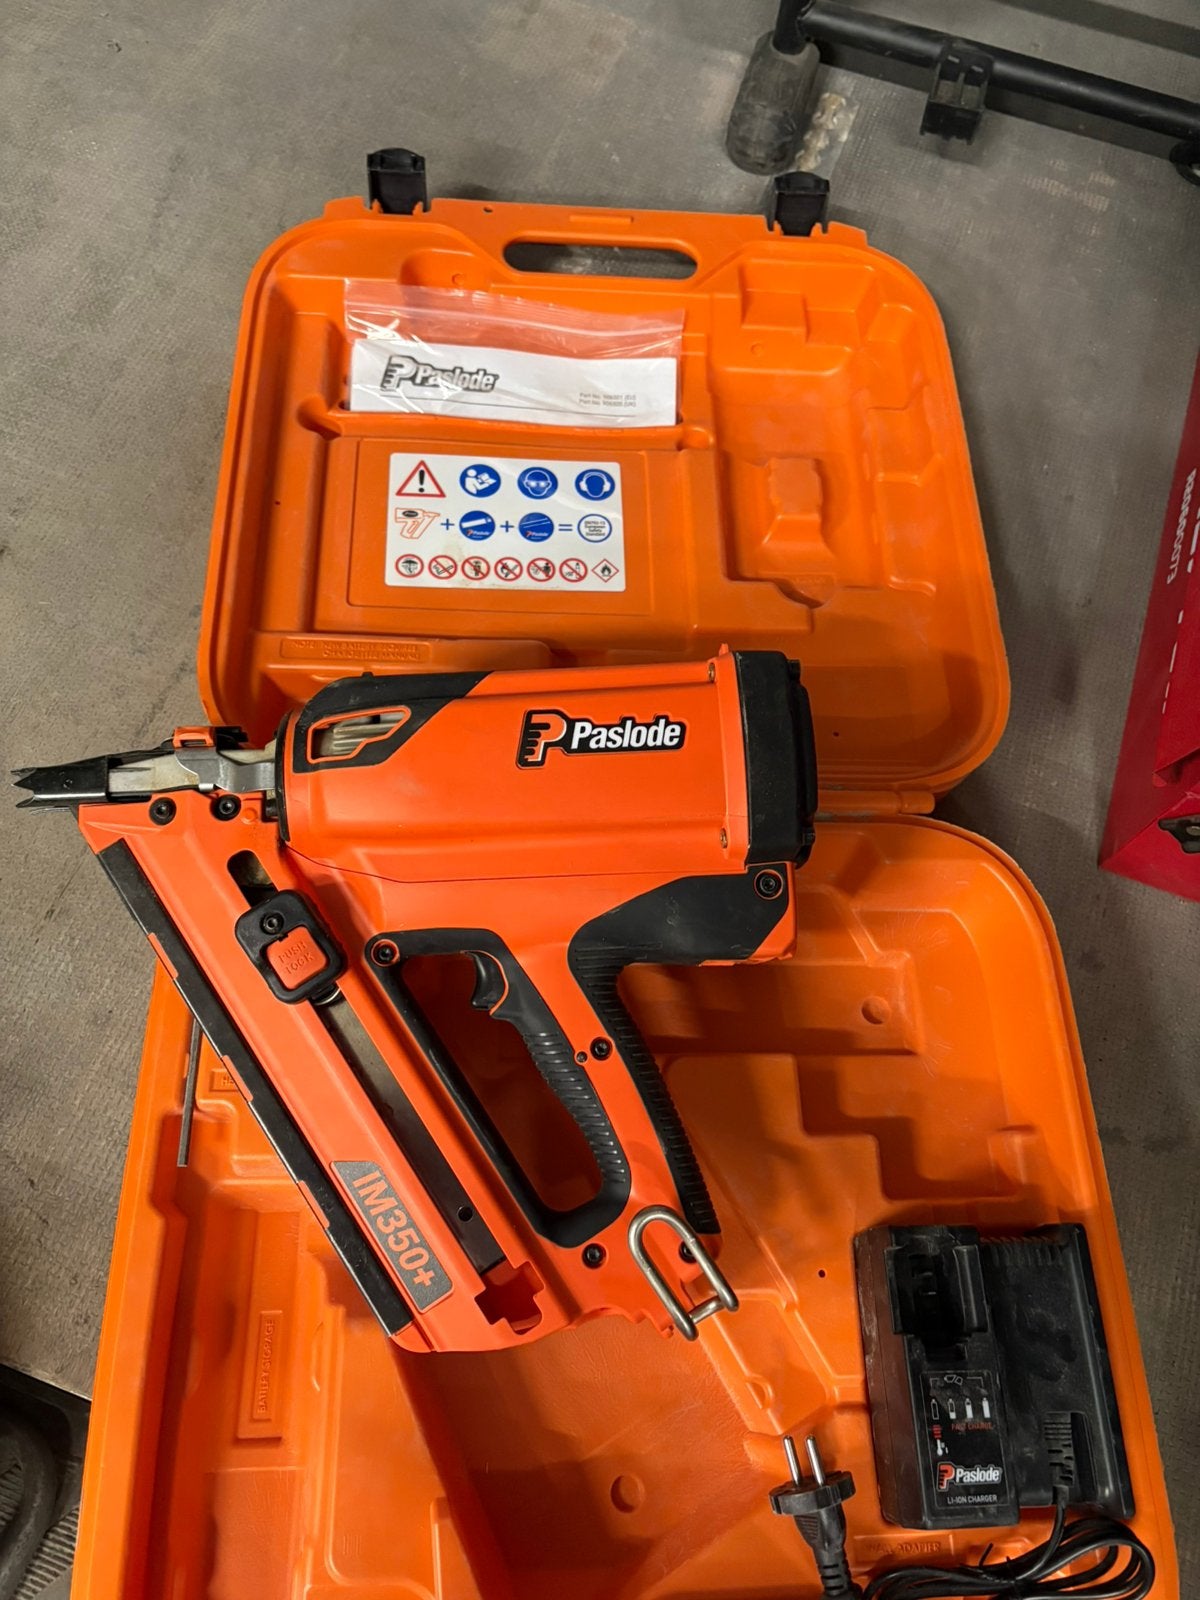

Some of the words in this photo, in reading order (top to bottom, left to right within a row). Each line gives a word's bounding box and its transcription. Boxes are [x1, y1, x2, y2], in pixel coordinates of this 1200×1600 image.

[414, 365, 495, 392] Paslode
[571, 718, 681, 750] Paslode
[278, 940, 308, 964] PUSH
[285, 952, 314, 975] LOCK
[352, 1170, 435, 1287] IM350+
[956, 1467, 1000, 1482] Paslode
[947, 1496, 967, 1505] LI-ION
[968, 1494, 998, 1504] CHARGER
